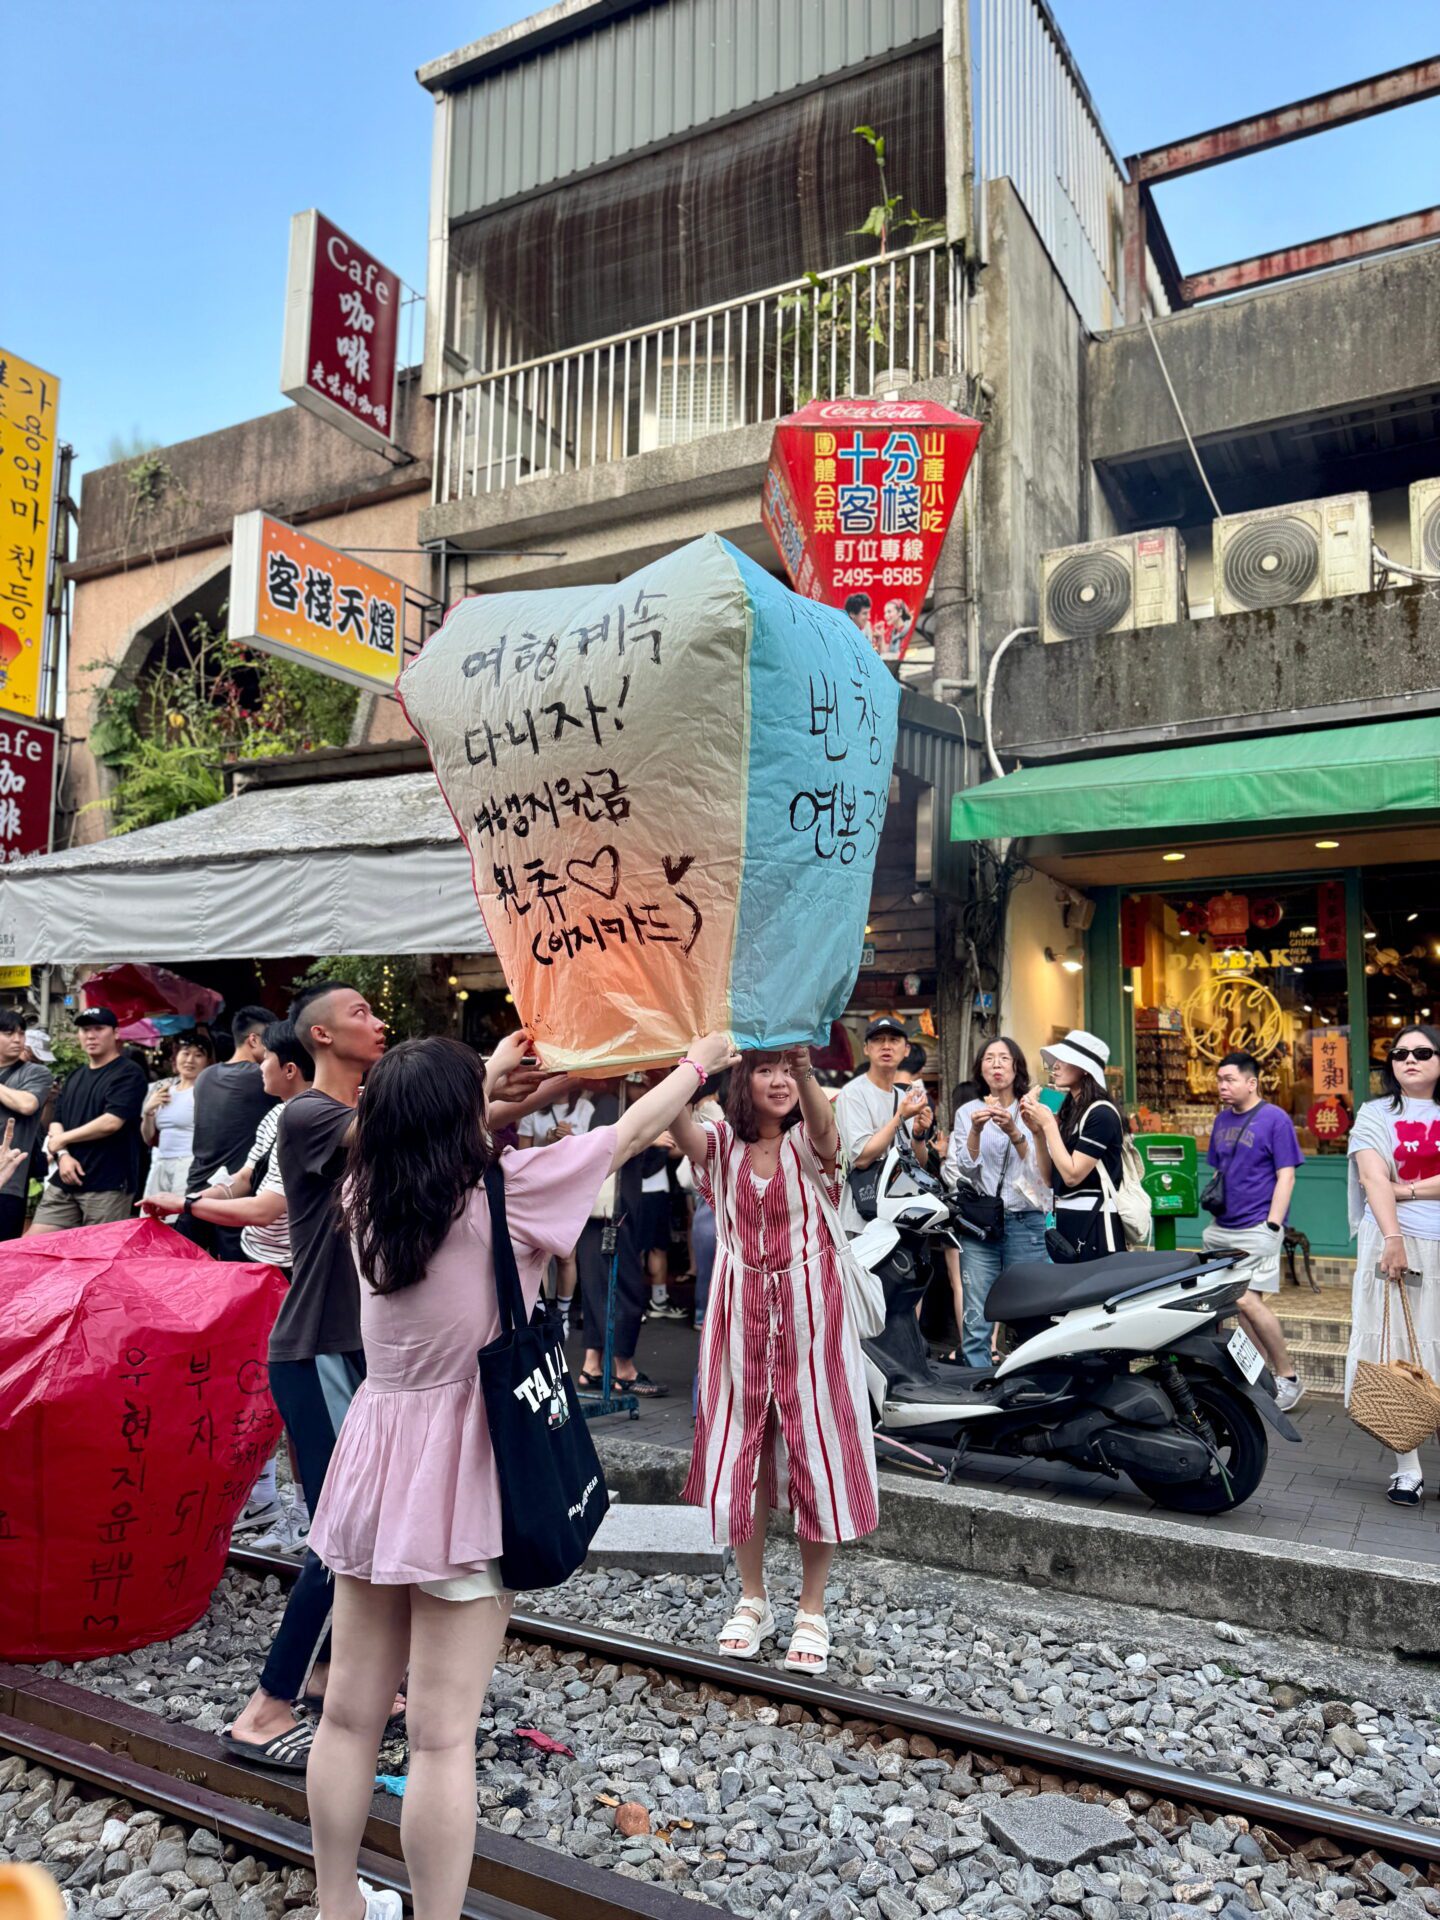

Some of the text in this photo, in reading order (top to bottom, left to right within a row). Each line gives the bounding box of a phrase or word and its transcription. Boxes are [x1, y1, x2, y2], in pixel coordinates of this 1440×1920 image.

[327, 236, 389, 305] Cafe
[336, 291, 375, 384] 咖啡
[820, 404, 926, 419] Coca-Cola
[814, 432, 836, 534] 團體合菜
[838, 431, 922, 484] 十分
[921, 431, 945, 533] 山產小吃
[837, 483, 922, 535] 客棧
[834, 539, 924, 562] 訂位專線
[832, 567, 923, 587] 2495-8585
[266, 553, 397, 655] 客棧天燈
[461, 589, 668, 687] 여행 계속
[0, 729, 43, 762] afe
[464, 674, 631, 767] 다니자!
[1167, 949, 1295, 971] DAEBAK
[1320, 1041, 1338, 1090] 好運來
[1314, 1108, 1341, 1134] 樂
